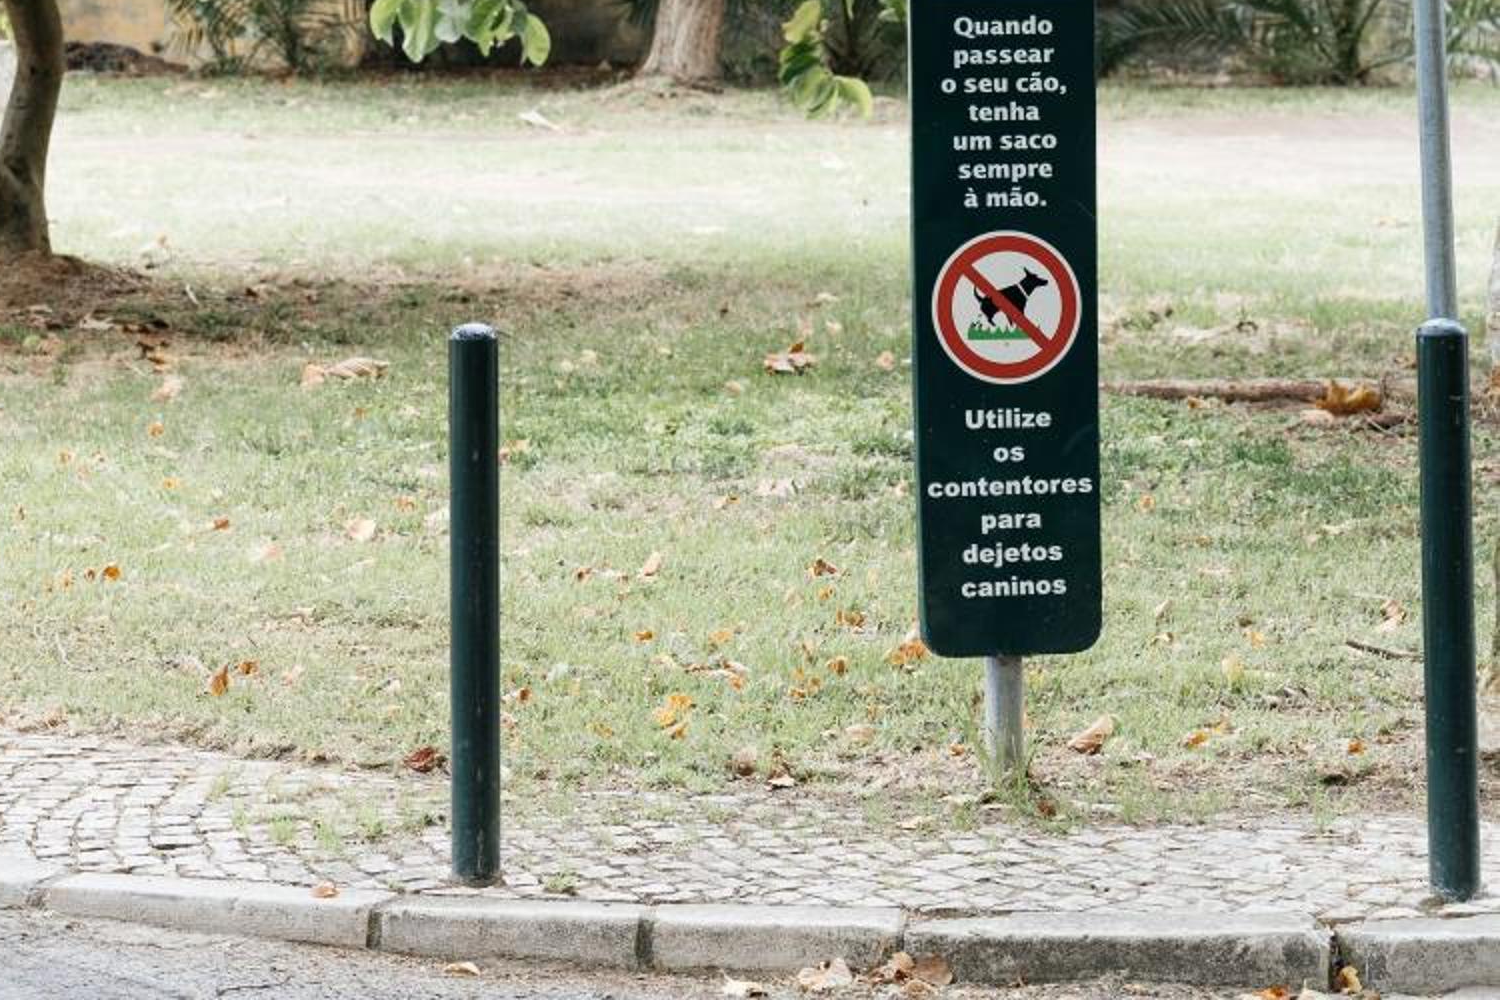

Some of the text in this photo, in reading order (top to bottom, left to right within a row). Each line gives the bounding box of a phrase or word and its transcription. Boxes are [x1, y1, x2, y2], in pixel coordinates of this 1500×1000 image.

[953, 15, 1054, 39] Quando
[953, 47, 1055, 69] passear
[941, 71, 1067, 95] o seu cão,
[968, 101, 1040, 122] tenha
[953, 133, 1057, 151] um saco
[958, 162, 1053, 183] sempre
[963, 186, 1047, 208] à mão.
[965, 407, 1052, 430] Utilize
[993, 446, 1025, 463] os
[927, 475, 1093, 498] contentores
[981, 513, 1042, 535] para
[962, 542, 1063, 568] dejetos
[961, 575, 1067, 598] caninos
